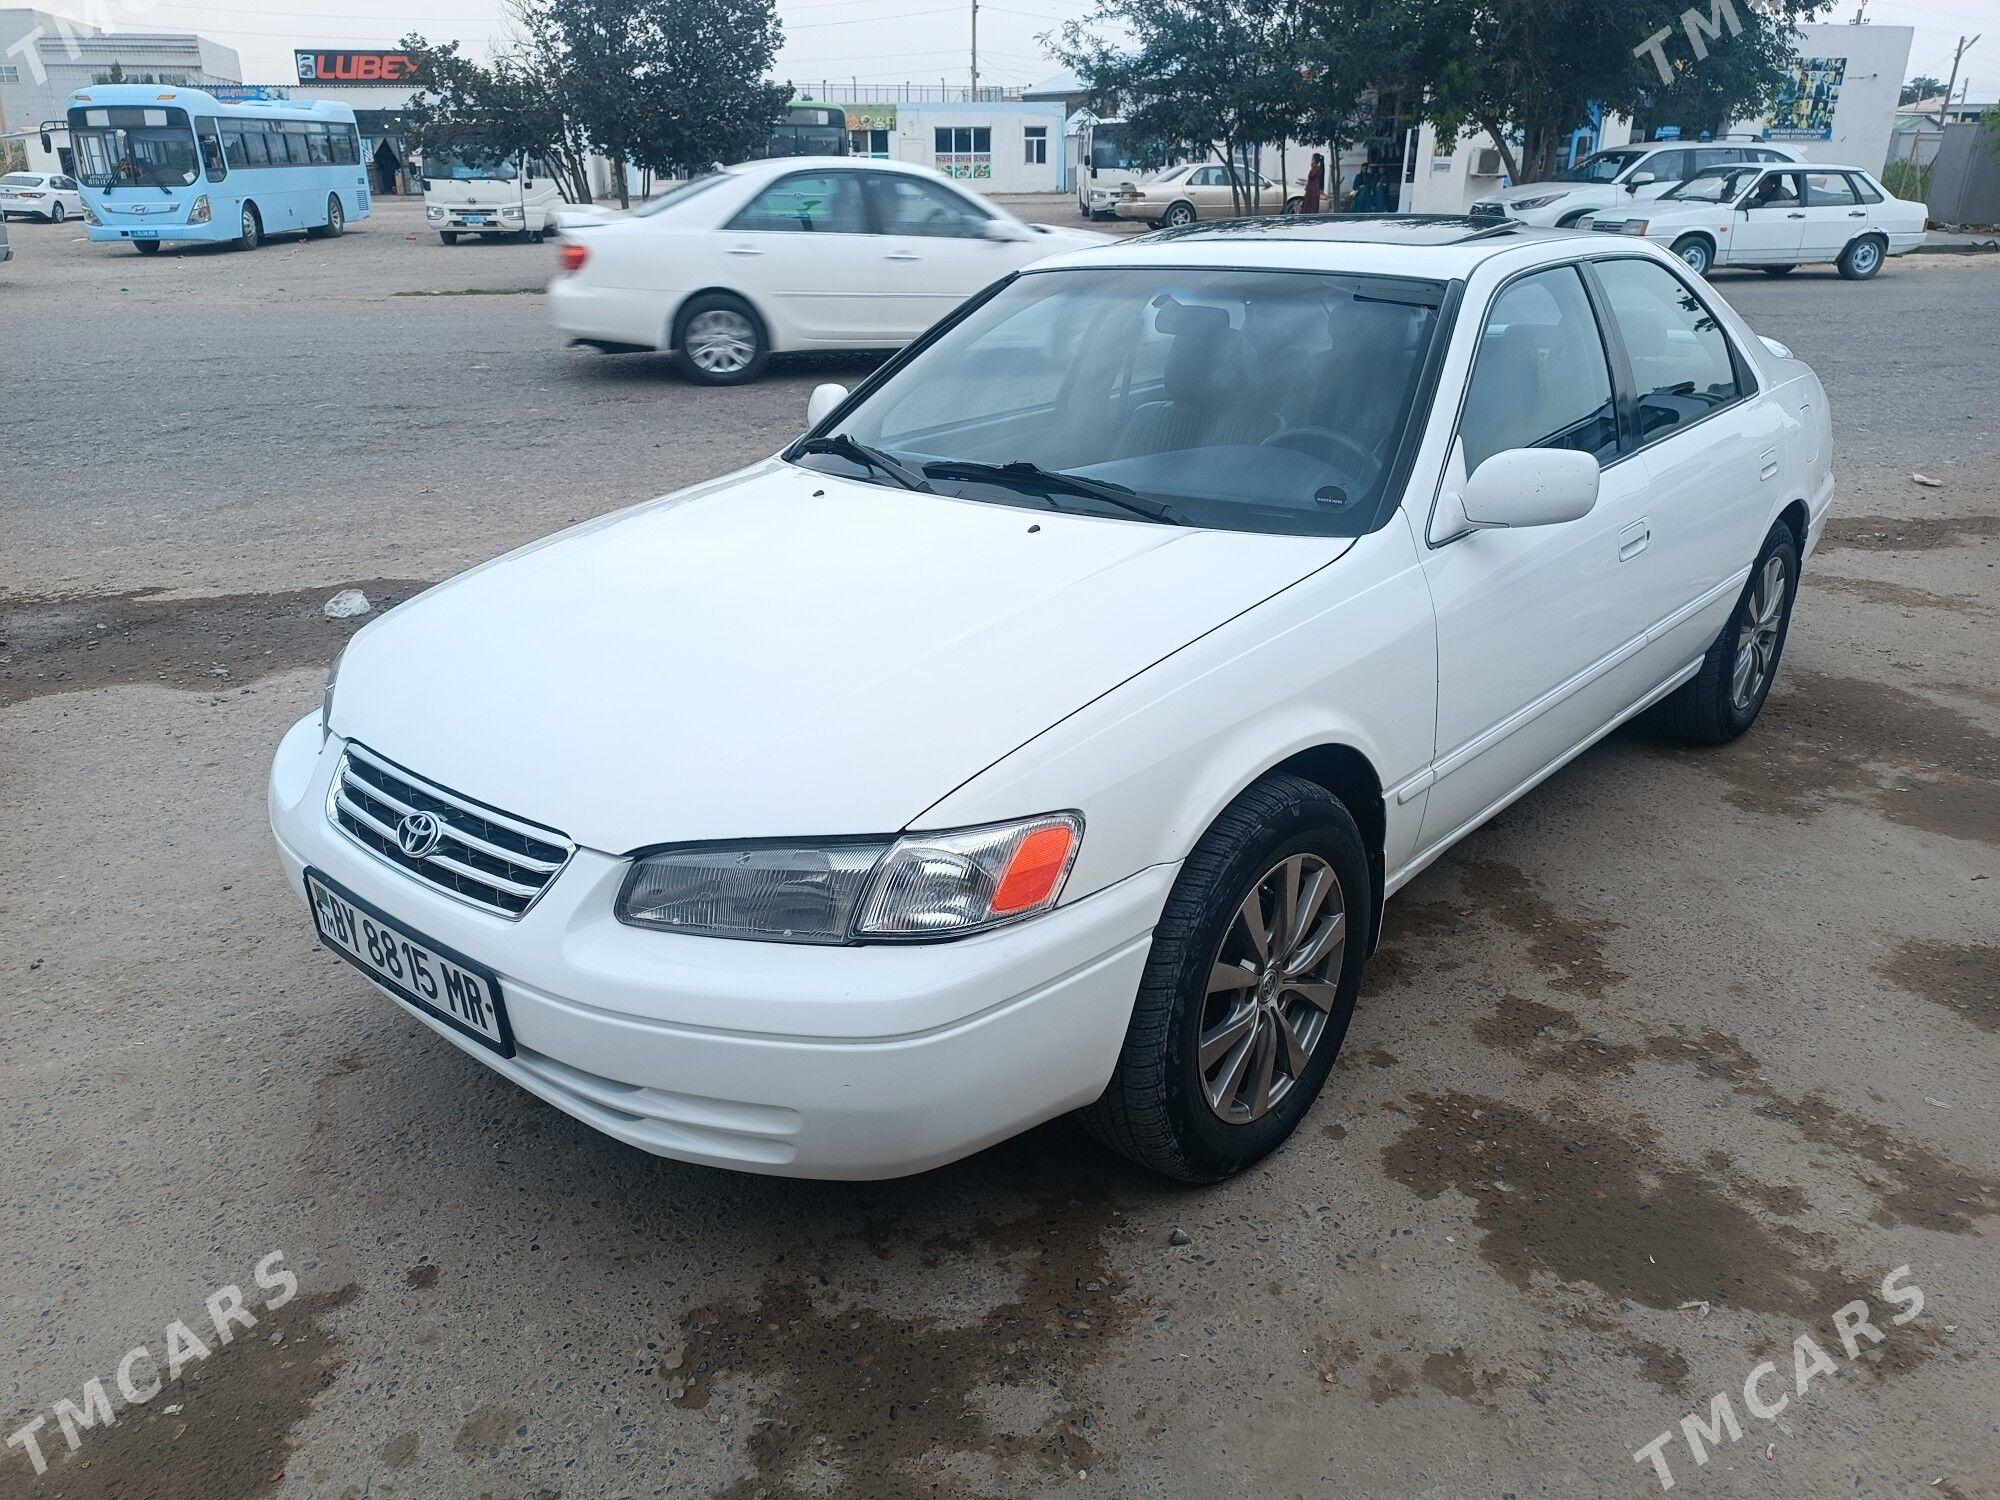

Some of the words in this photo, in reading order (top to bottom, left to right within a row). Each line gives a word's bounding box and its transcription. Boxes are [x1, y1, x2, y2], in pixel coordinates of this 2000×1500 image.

[328, 894, 361, 954] BY
[362, 919, 438, 1000] 8815
[440, 962, 489, 1031] MR
